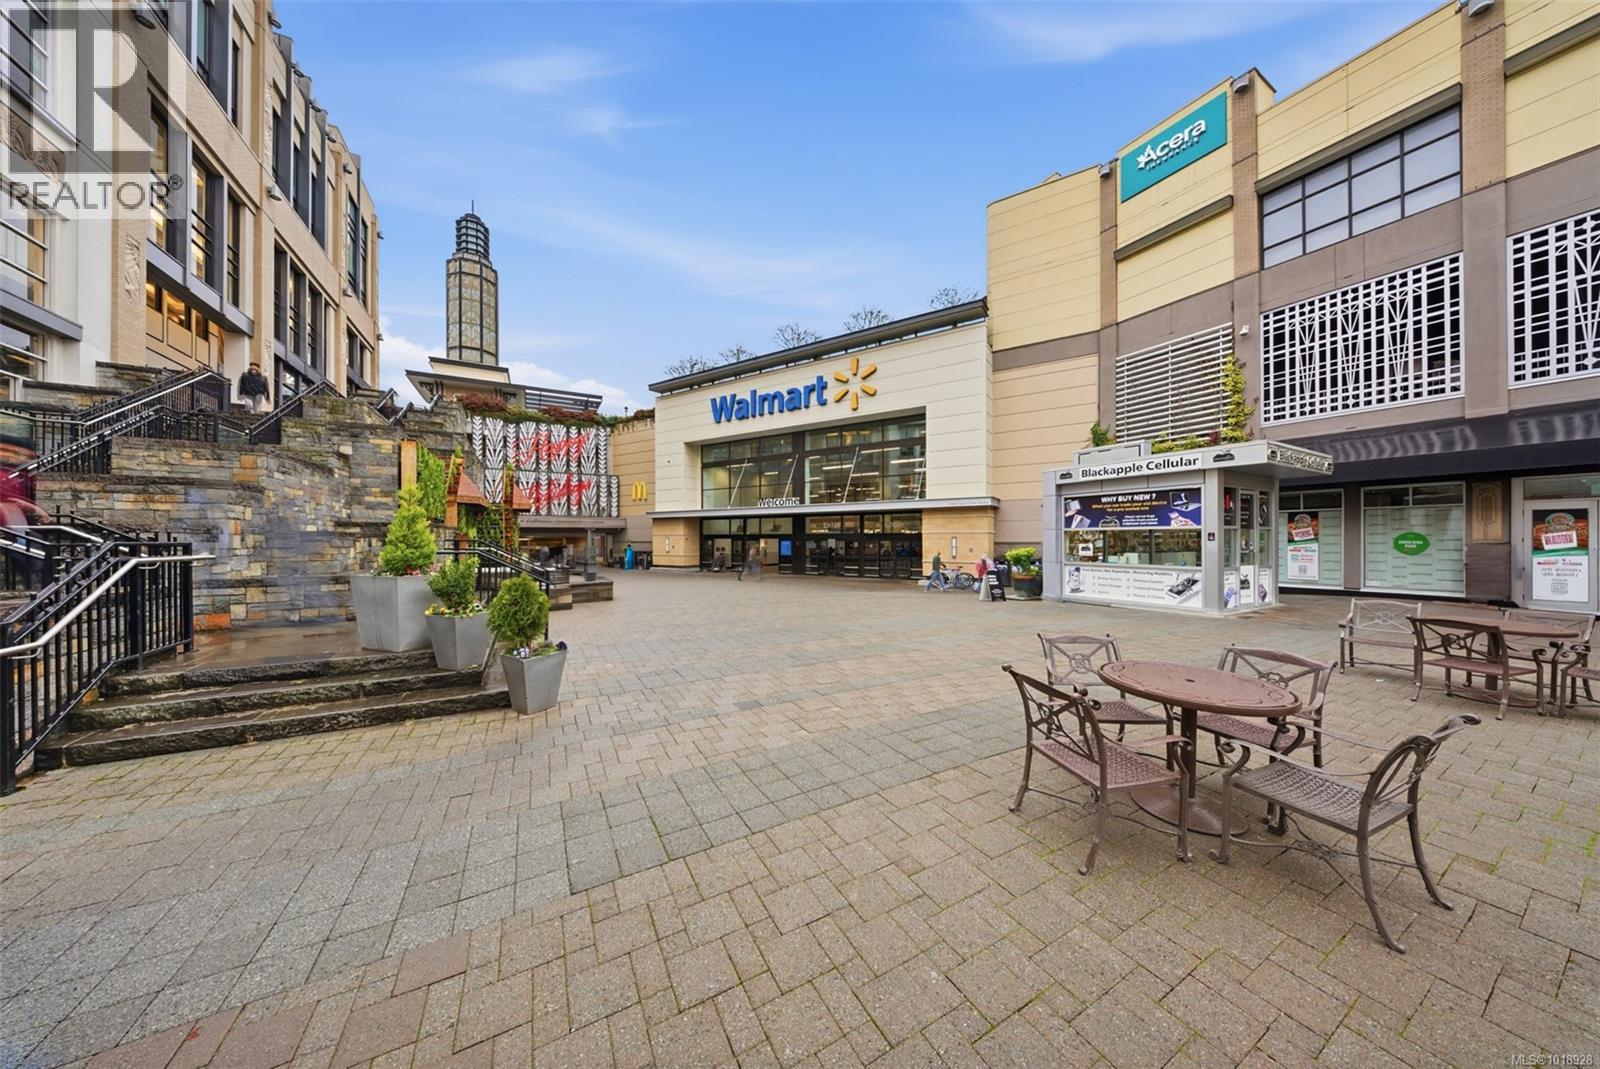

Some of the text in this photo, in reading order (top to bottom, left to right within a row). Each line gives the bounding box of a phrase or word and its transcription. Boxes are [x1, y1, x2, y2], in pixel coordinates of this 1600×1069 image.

[1137, 119, 1206, 170] Acera
[710, 375, 828, 424] Walmart
[1081, 457, 1199, 478] Blackapple Cellular
[1133, 493, 1151, 501] NEW
